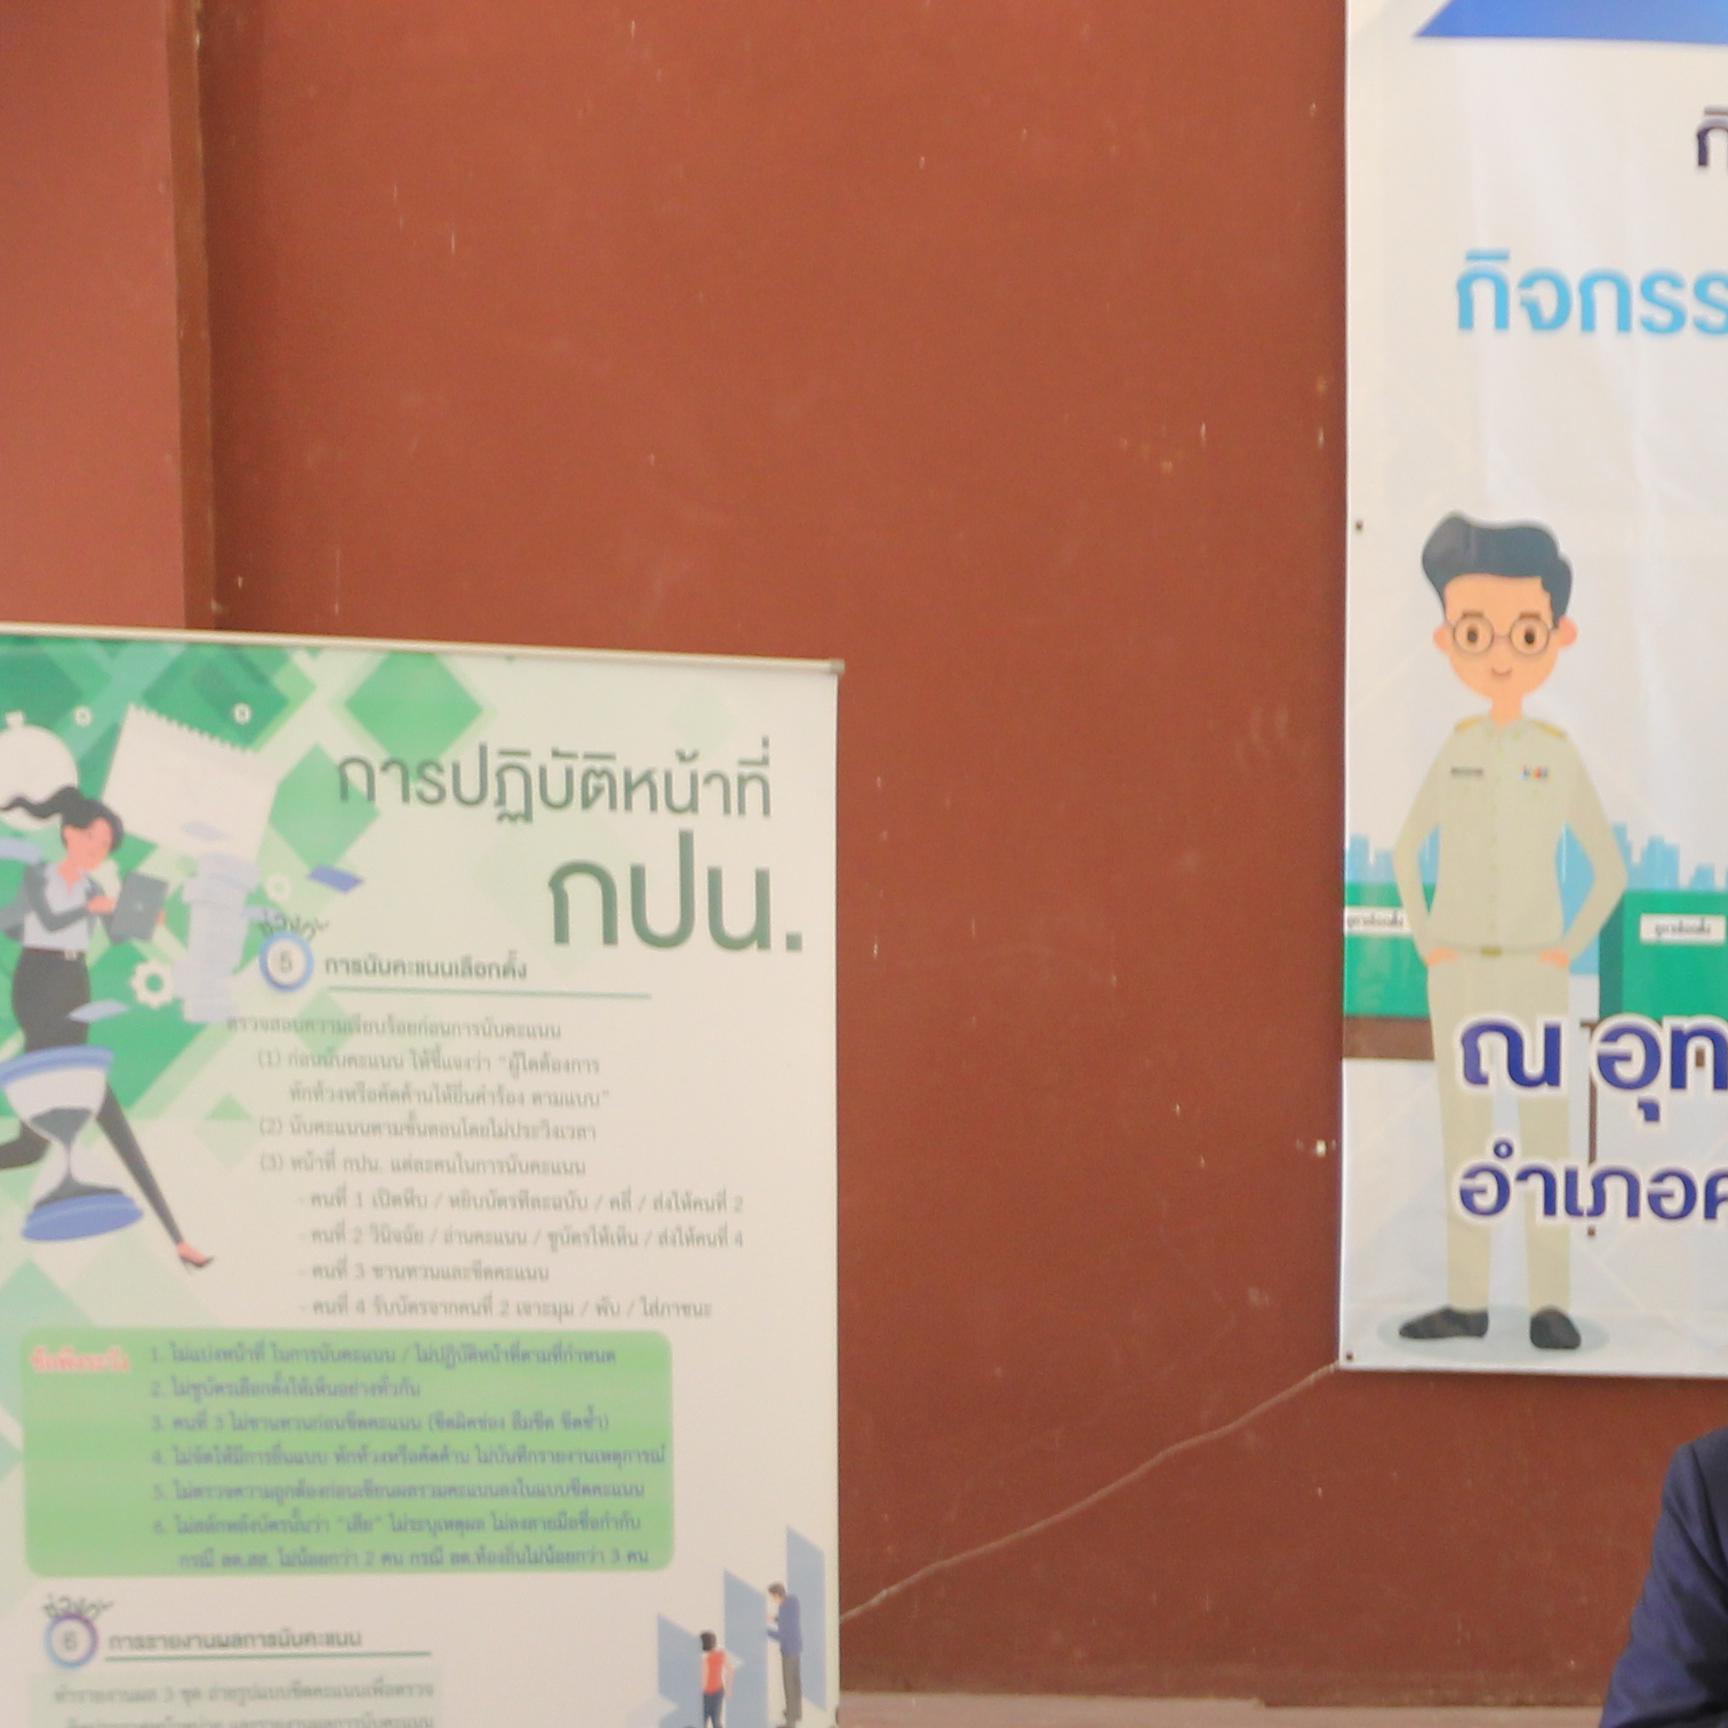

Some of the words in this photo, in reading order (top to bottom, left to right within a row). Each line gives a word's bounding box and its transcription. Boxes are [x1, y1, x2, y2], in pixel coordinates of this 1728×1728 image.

[548, 829, 803, 951] กปน.
[257, 1050, 281, 1071] (1)
[1459, 1014, 1561, 1092] ณ
[259, 1117, 283, 1137] (2)
[260, 1154, 284, 1174] (3)
